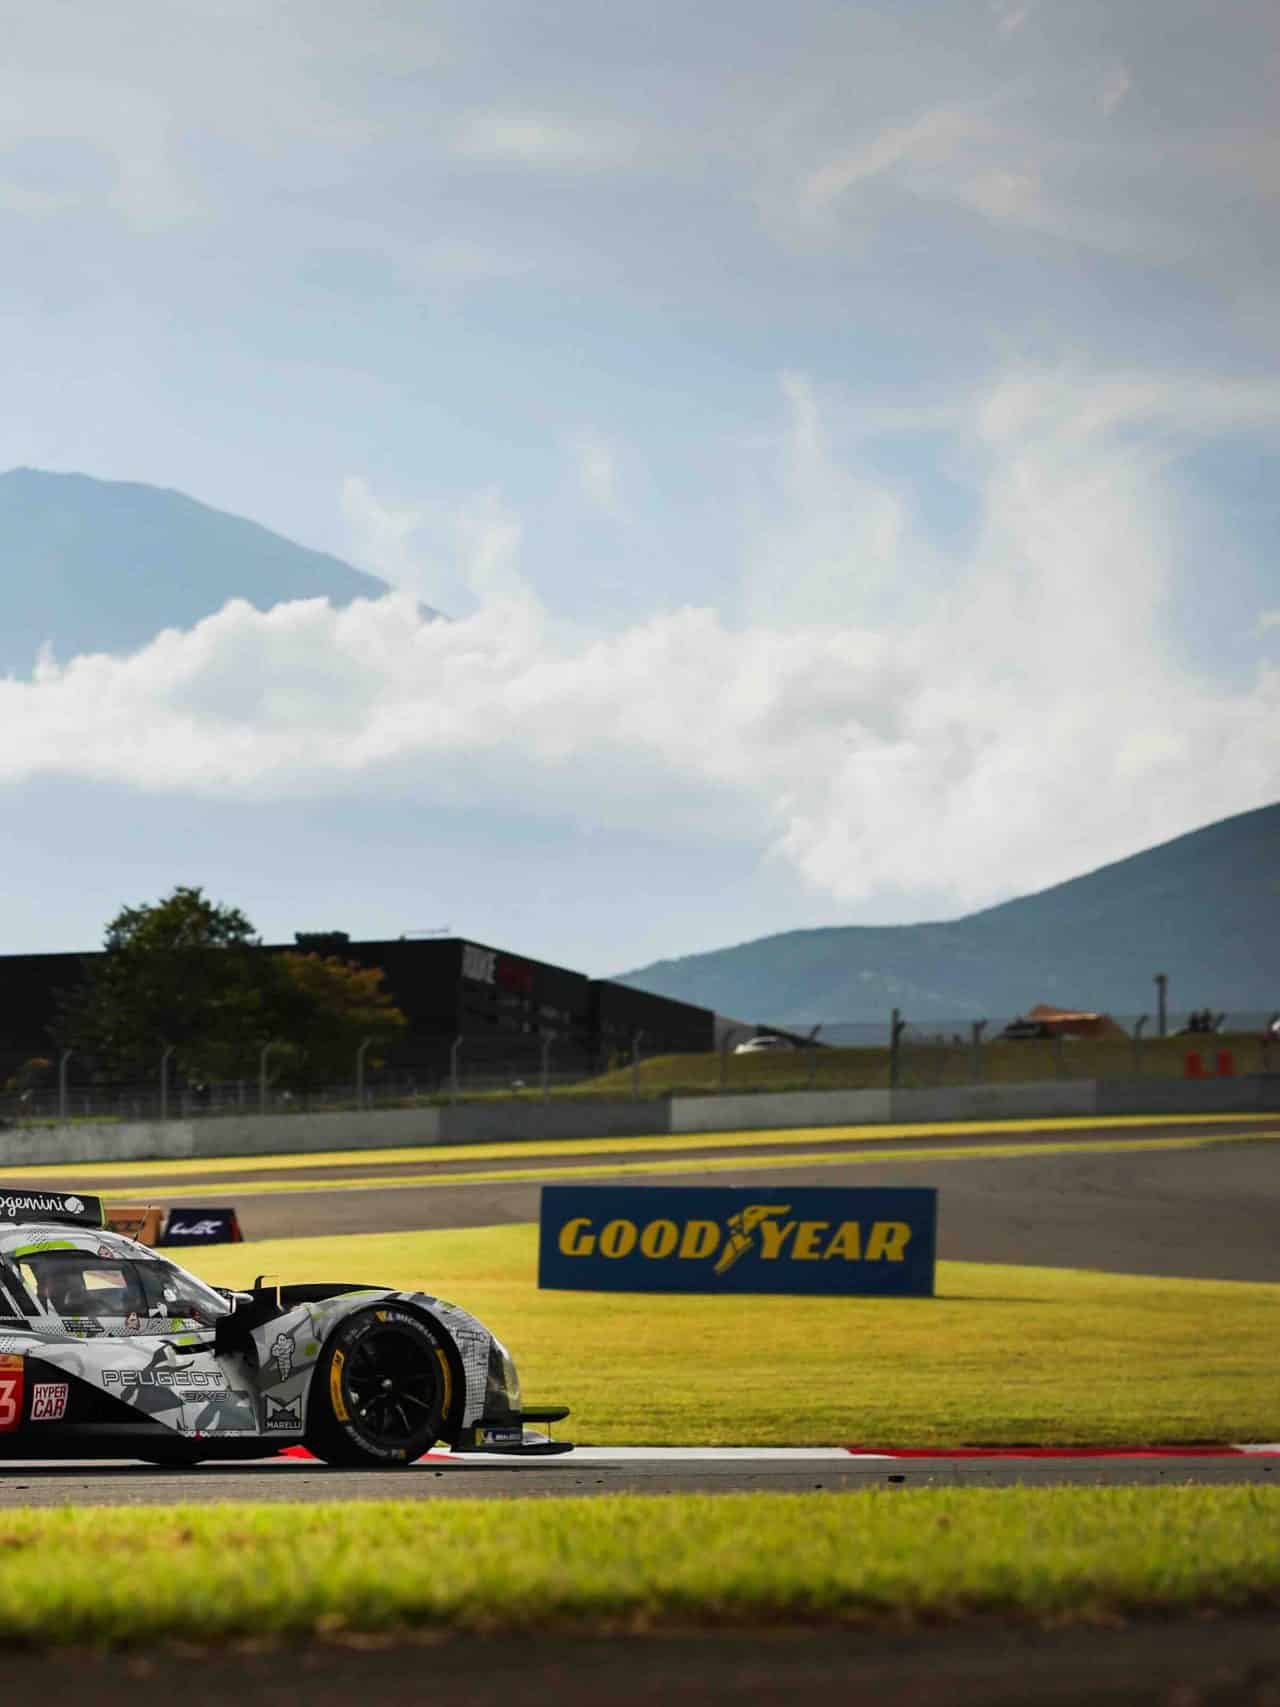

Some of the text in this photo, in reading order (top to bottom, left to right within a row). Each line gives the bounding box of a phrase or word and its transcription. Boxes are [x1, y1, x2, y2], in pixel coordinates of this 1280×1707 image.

[171, 1220, 223, 1235] WEC
[102, 1369, 224, 1387] PEUGEOT
[34, 1383, 67, 1400] HYPER
[33, 1399, 65, 1419] CAR
[266, 1421, 302, 1430] MARELLI
